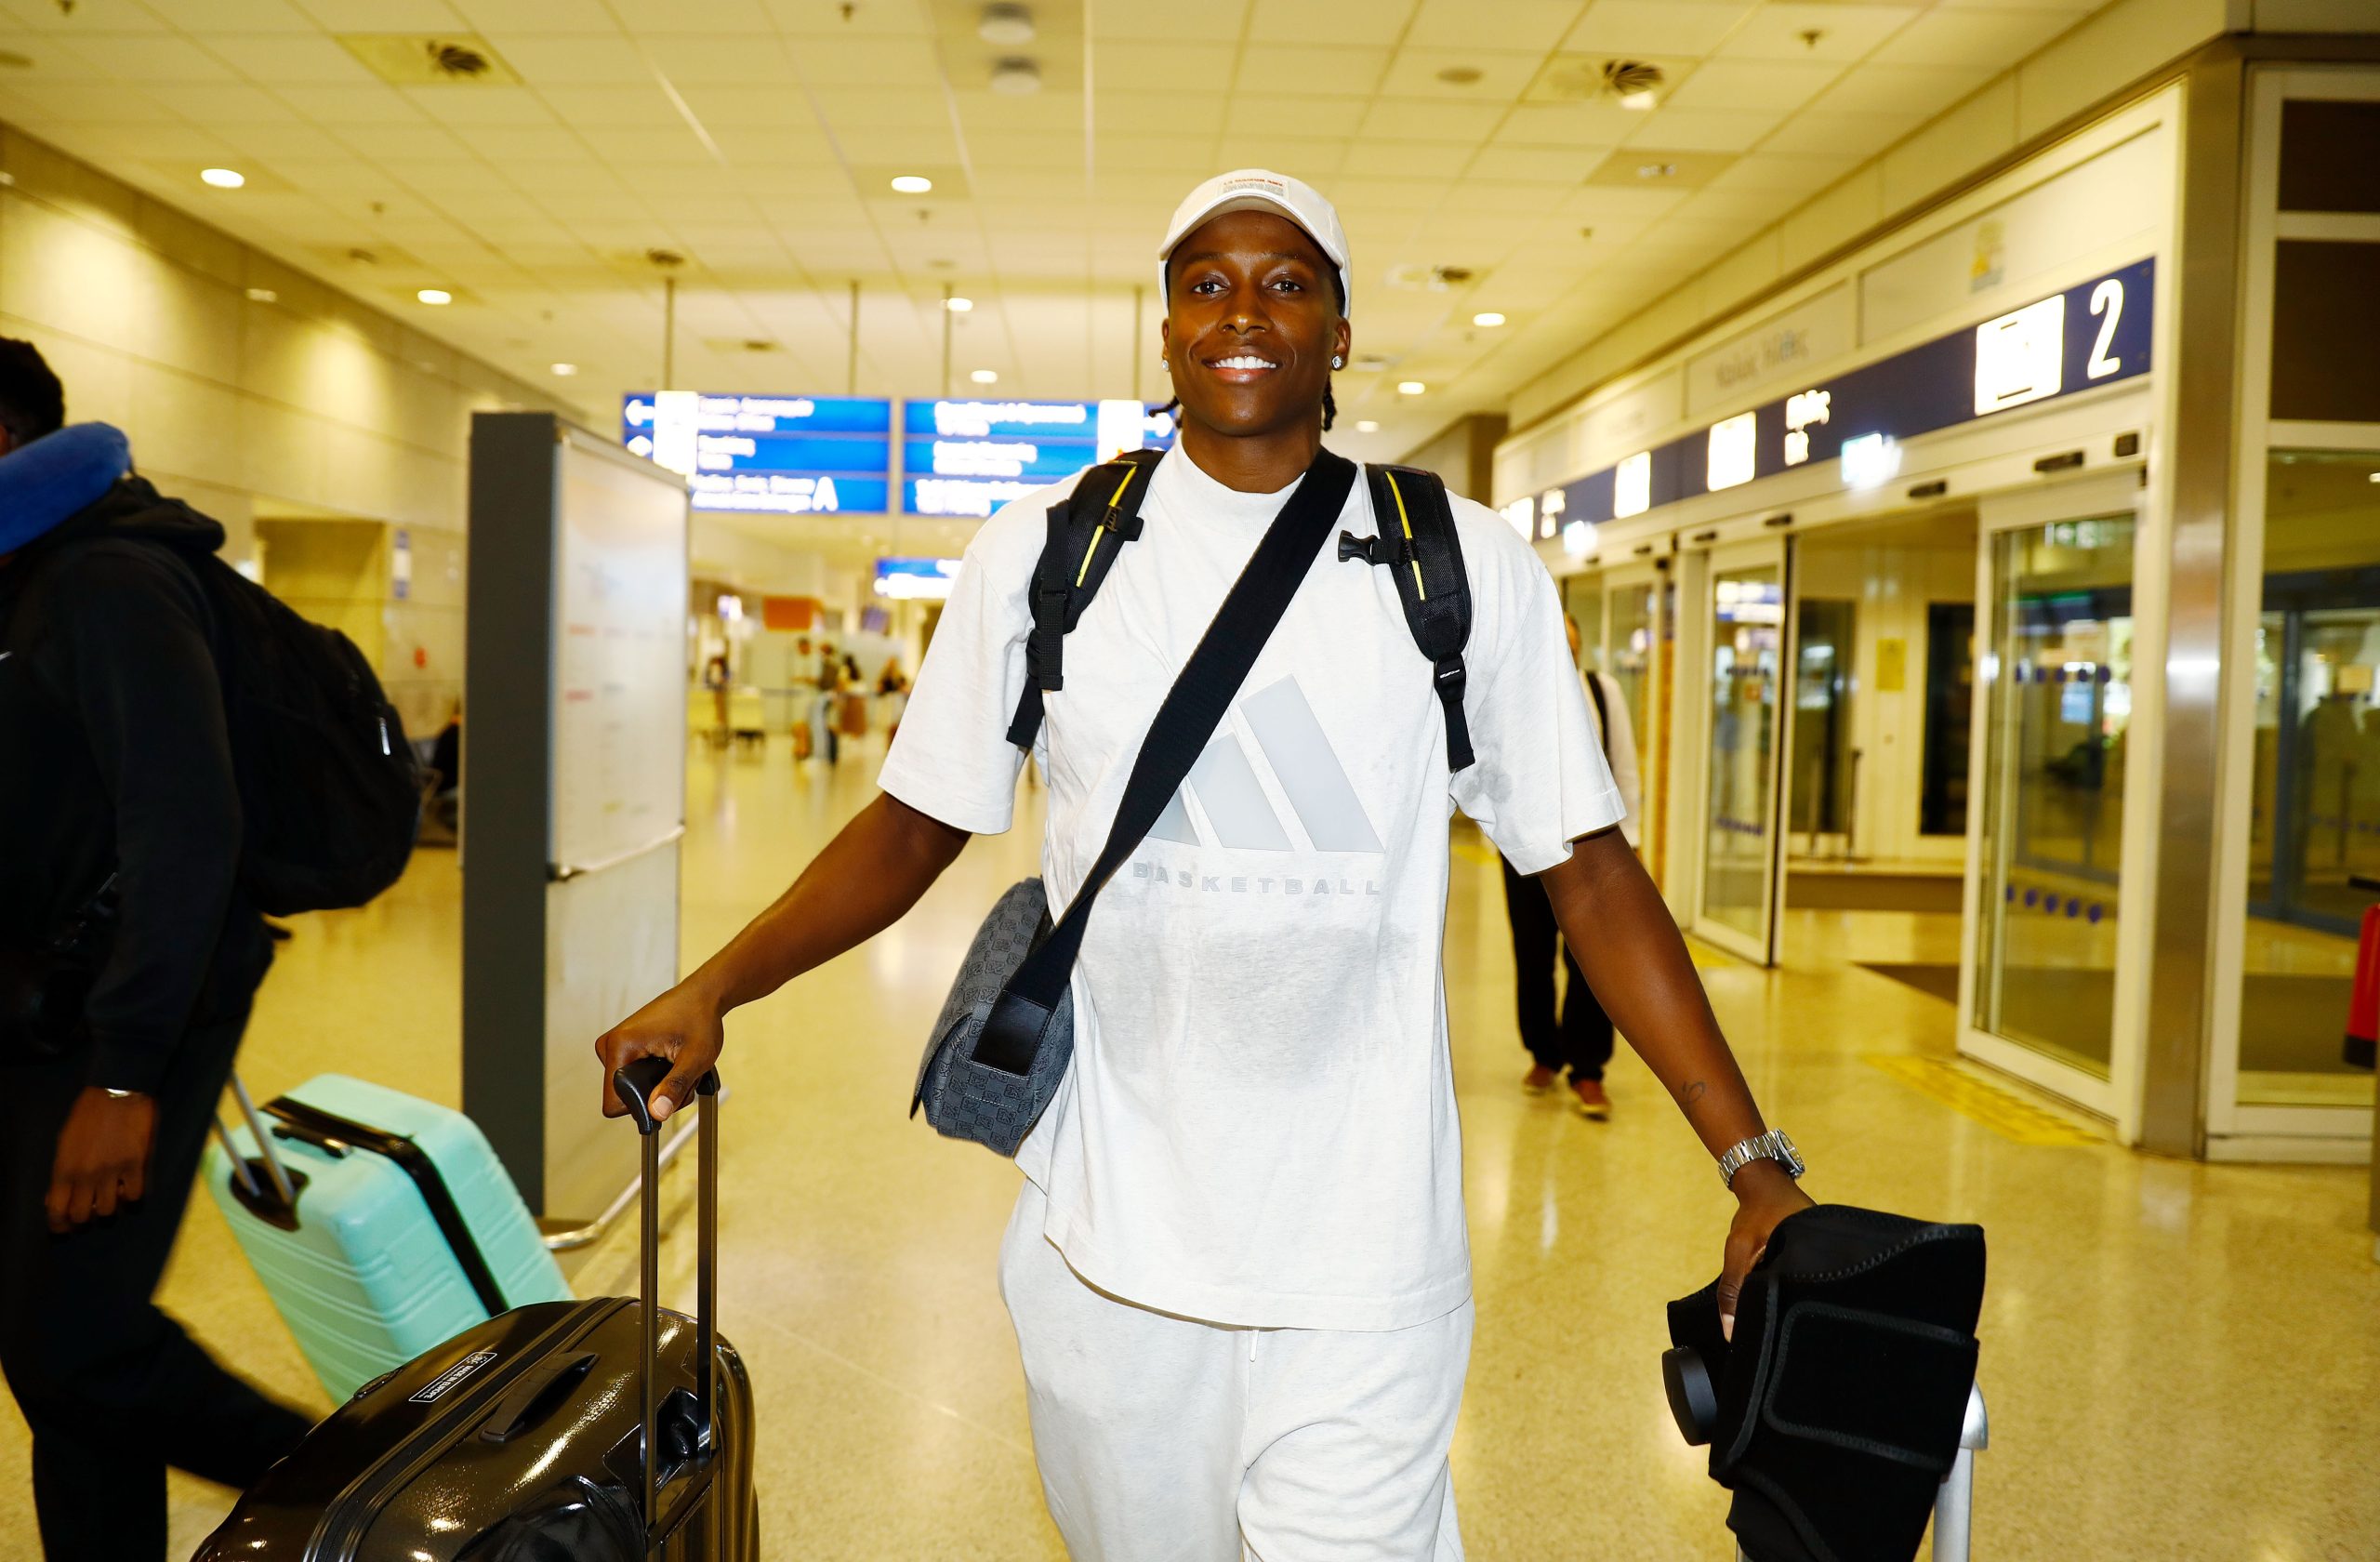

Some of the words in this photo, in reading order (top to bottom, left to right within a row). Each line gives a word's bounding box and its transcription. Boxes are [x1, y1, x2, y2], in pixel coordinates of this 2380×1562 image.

[2087, 279, 2124, 380] 2
[812, 476, 839, 511] A
[1132, 862, 1381, 895] BASKETBALL
